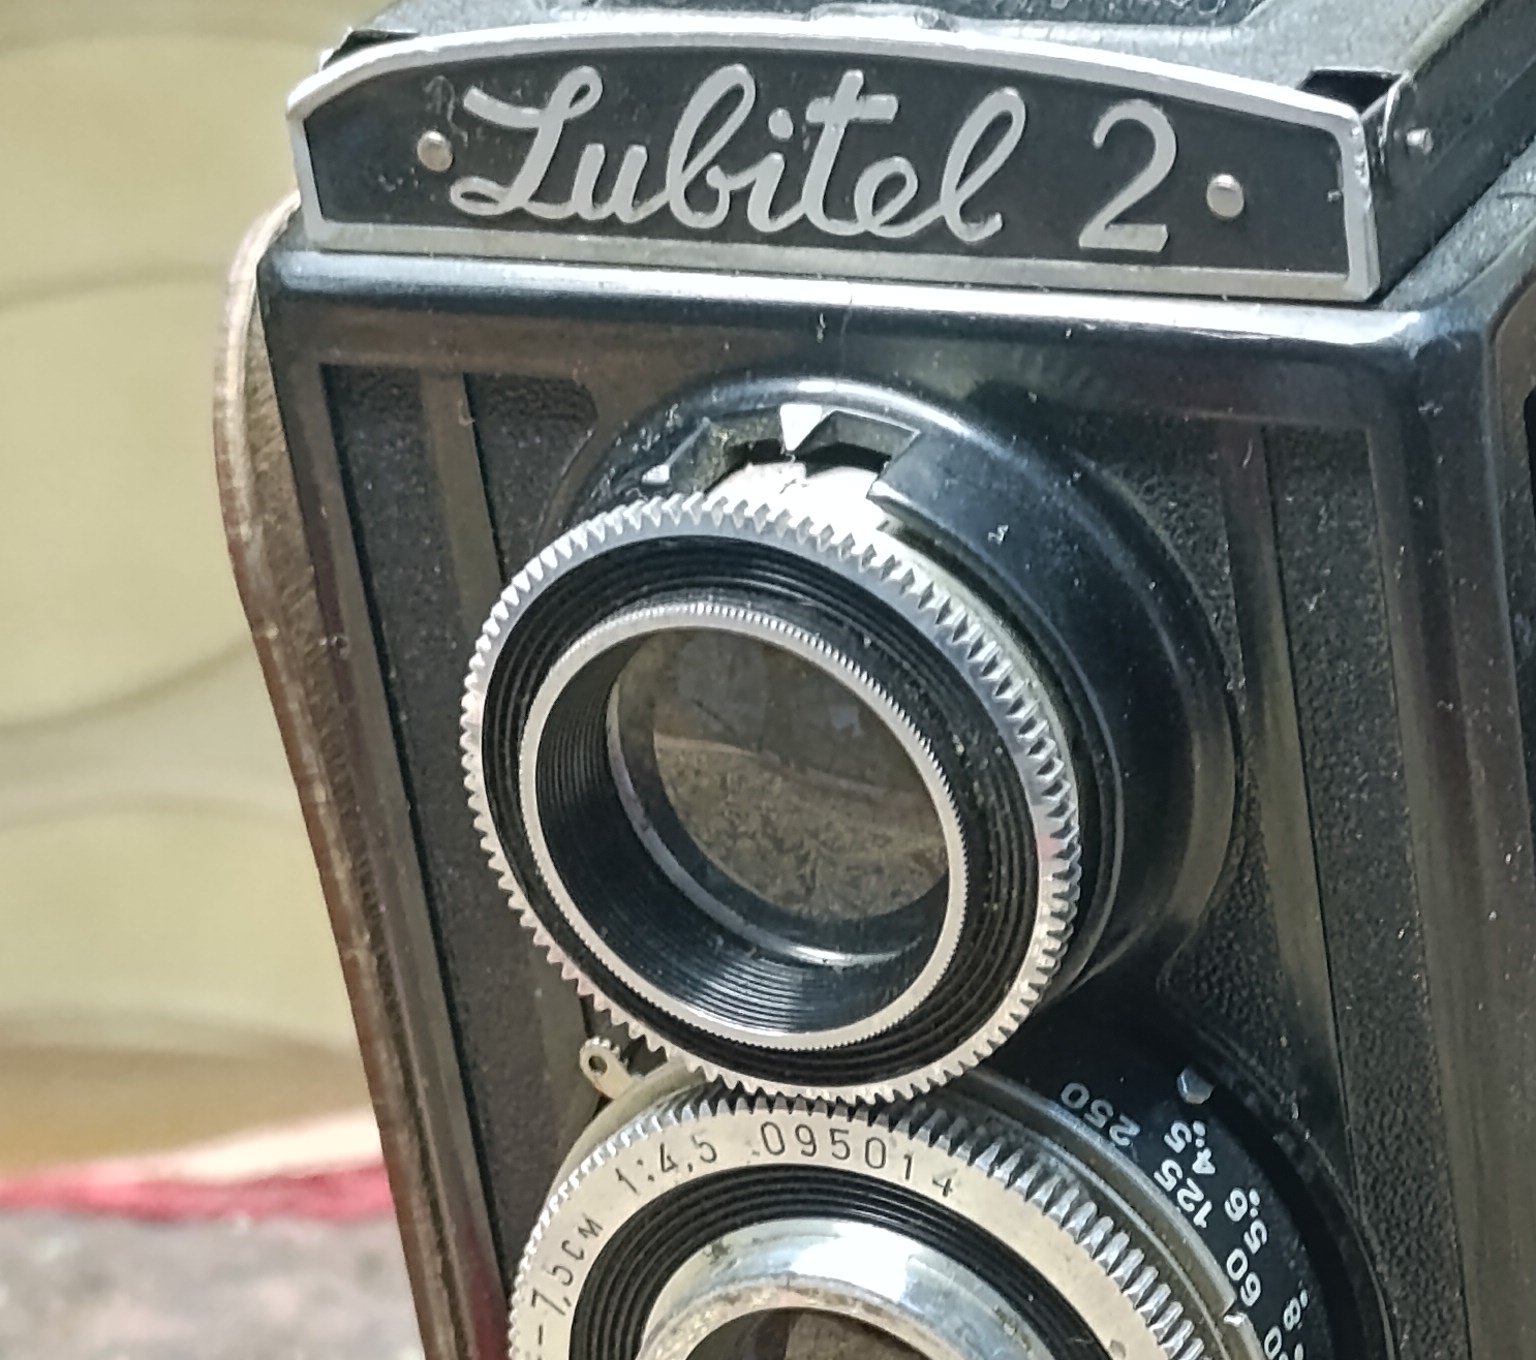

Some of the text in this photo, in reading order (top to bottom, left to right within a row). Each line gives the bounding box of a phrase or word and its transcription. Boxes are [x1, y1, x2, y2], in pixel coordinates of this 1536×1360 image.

[449, 62, 1180, 253] Lubitel 2
[1060, 1082, 1141, 1146] 250
[1163, 1119, 1216, 1175] 4.5
[1153, 1158, 1213, 1229] 125
[1224, 1186, 1268, 1255] 5.6
[1226, 1248, 1262, 1307] 60
[1283, 1296, 1301, 1331] 8
